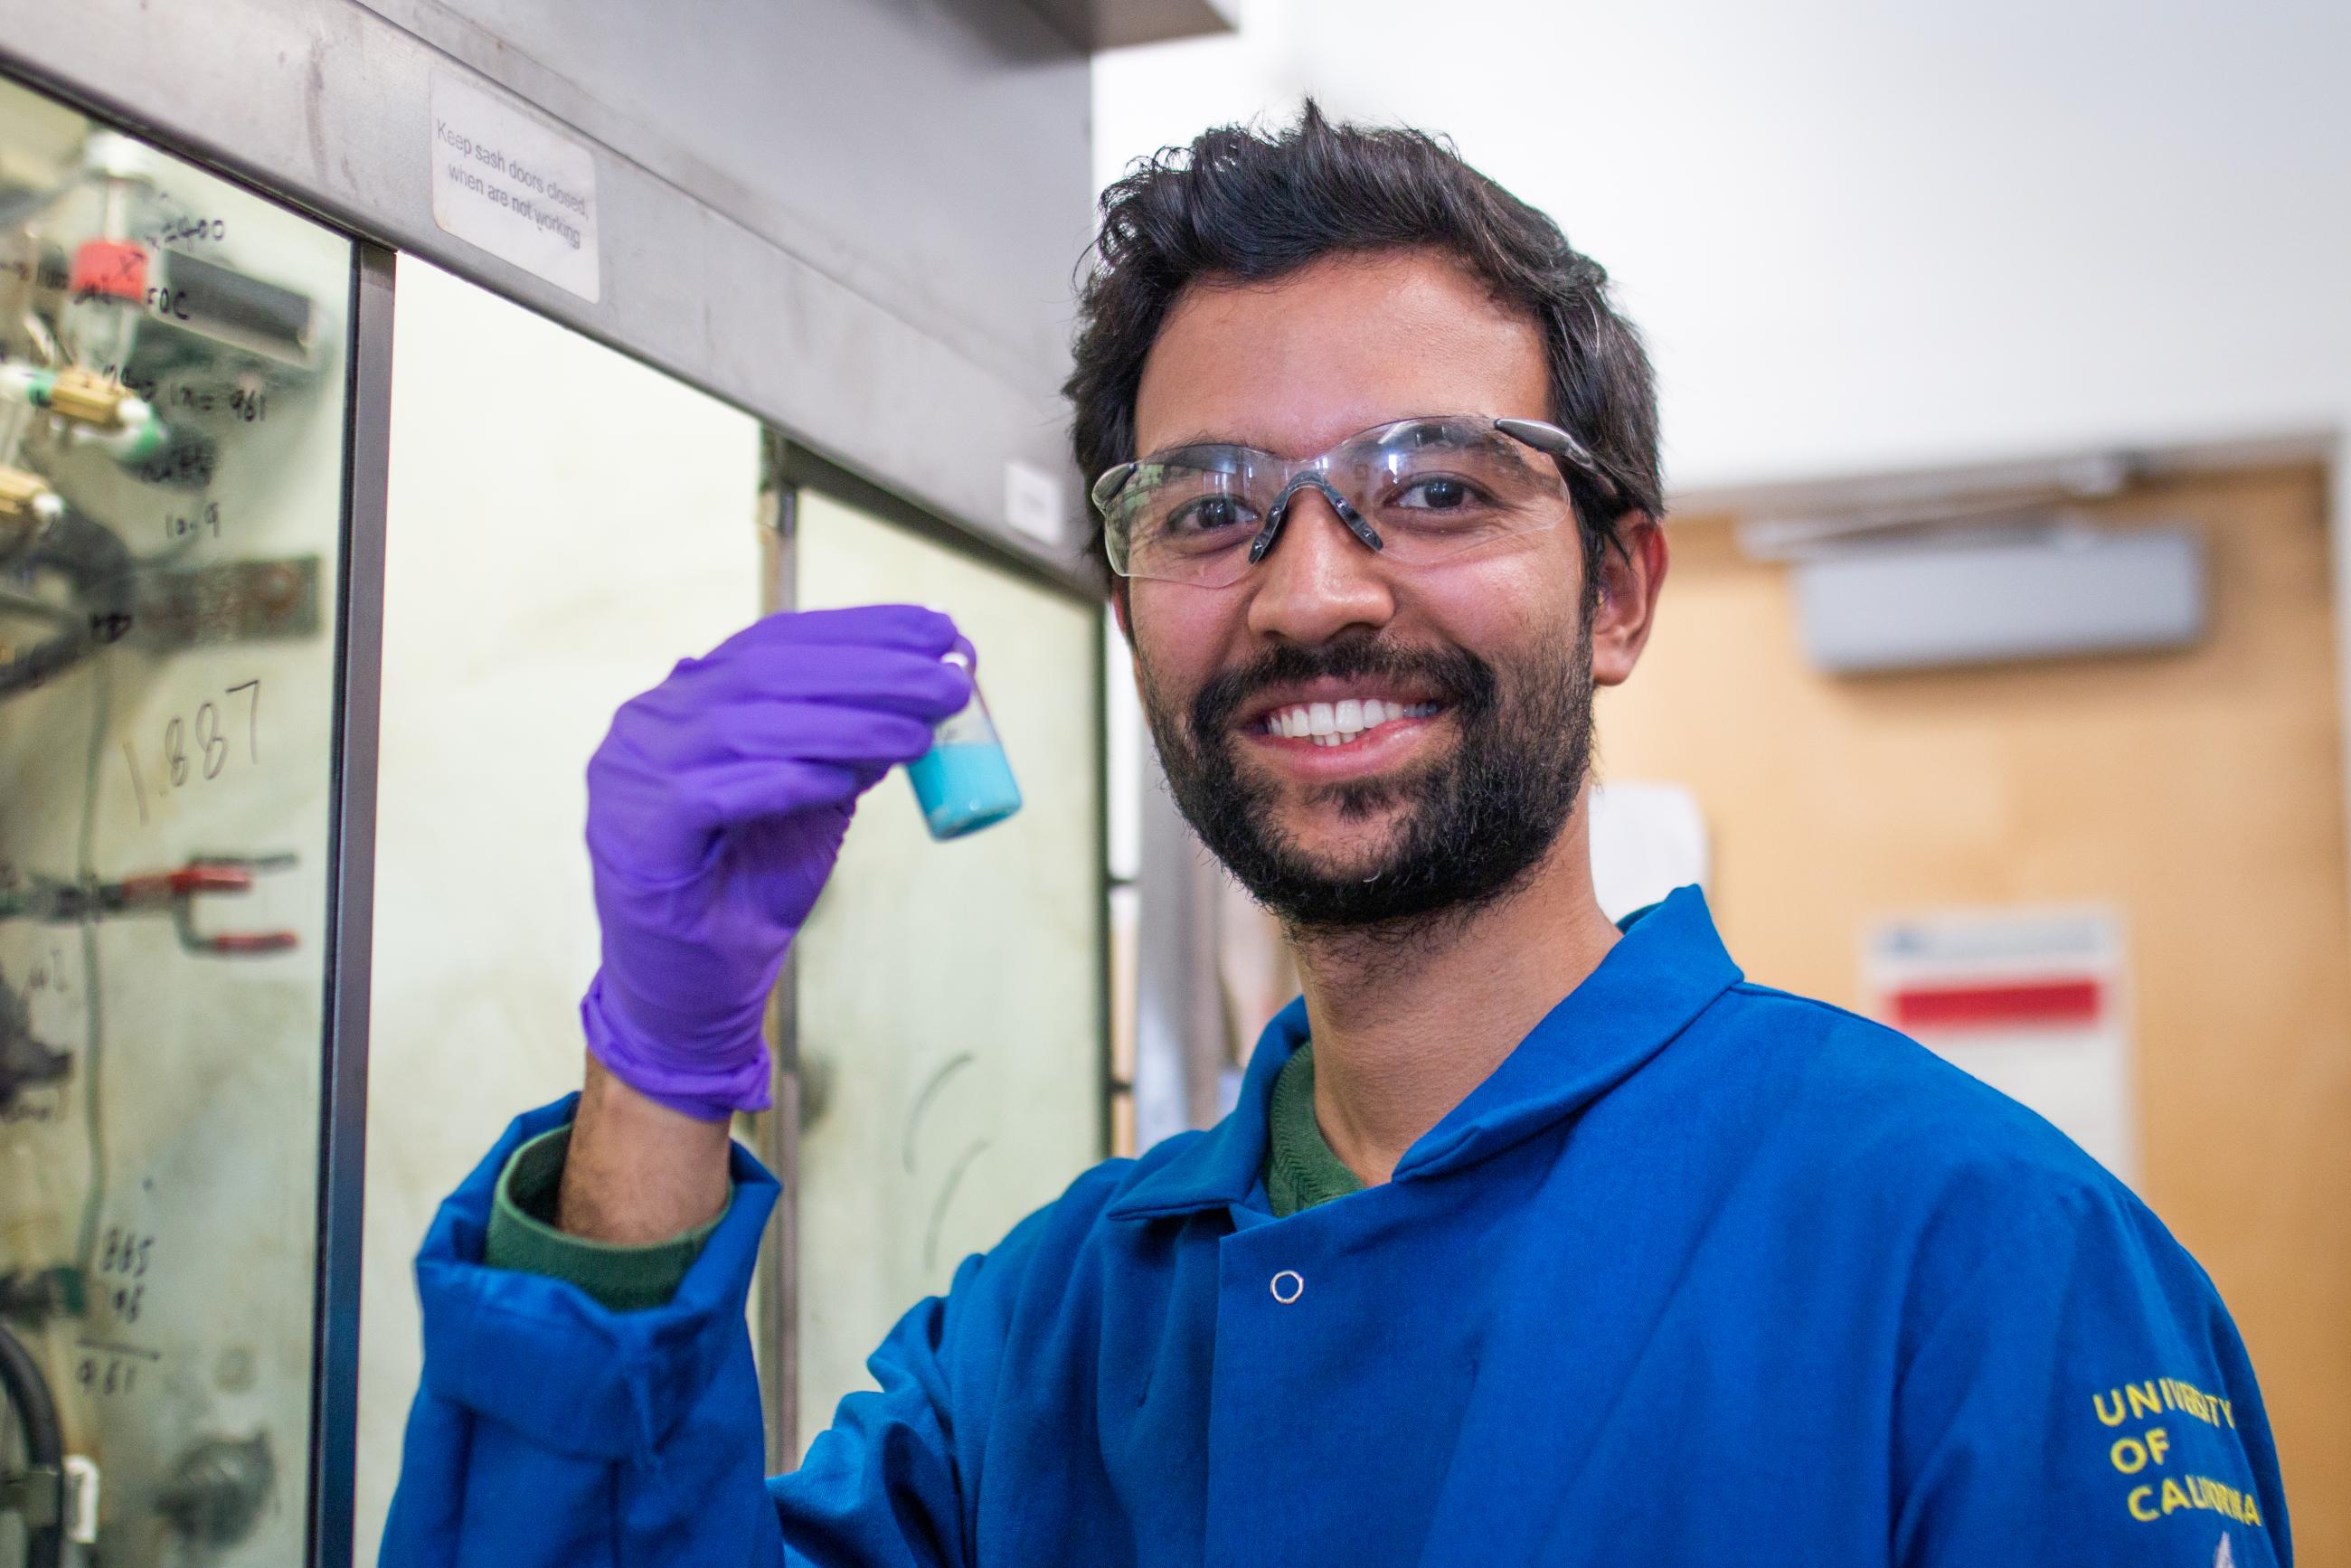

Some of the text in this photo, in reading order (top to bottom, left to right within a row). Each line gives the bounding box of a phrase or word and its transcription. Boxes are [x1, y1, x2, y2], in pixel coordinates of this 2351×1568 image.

[437, 119, 472, 157] Keep
[475, 144, 505, 173] sash
[509, 159, 543, 194] doors
[448, 163, 581, 250] when are not working
[2092, 1377, 2236, 1429] UNIVITY
[2110, 1428, 2170, 1475] OF
[2127, 1474, 2262, 1526] CALIIA
